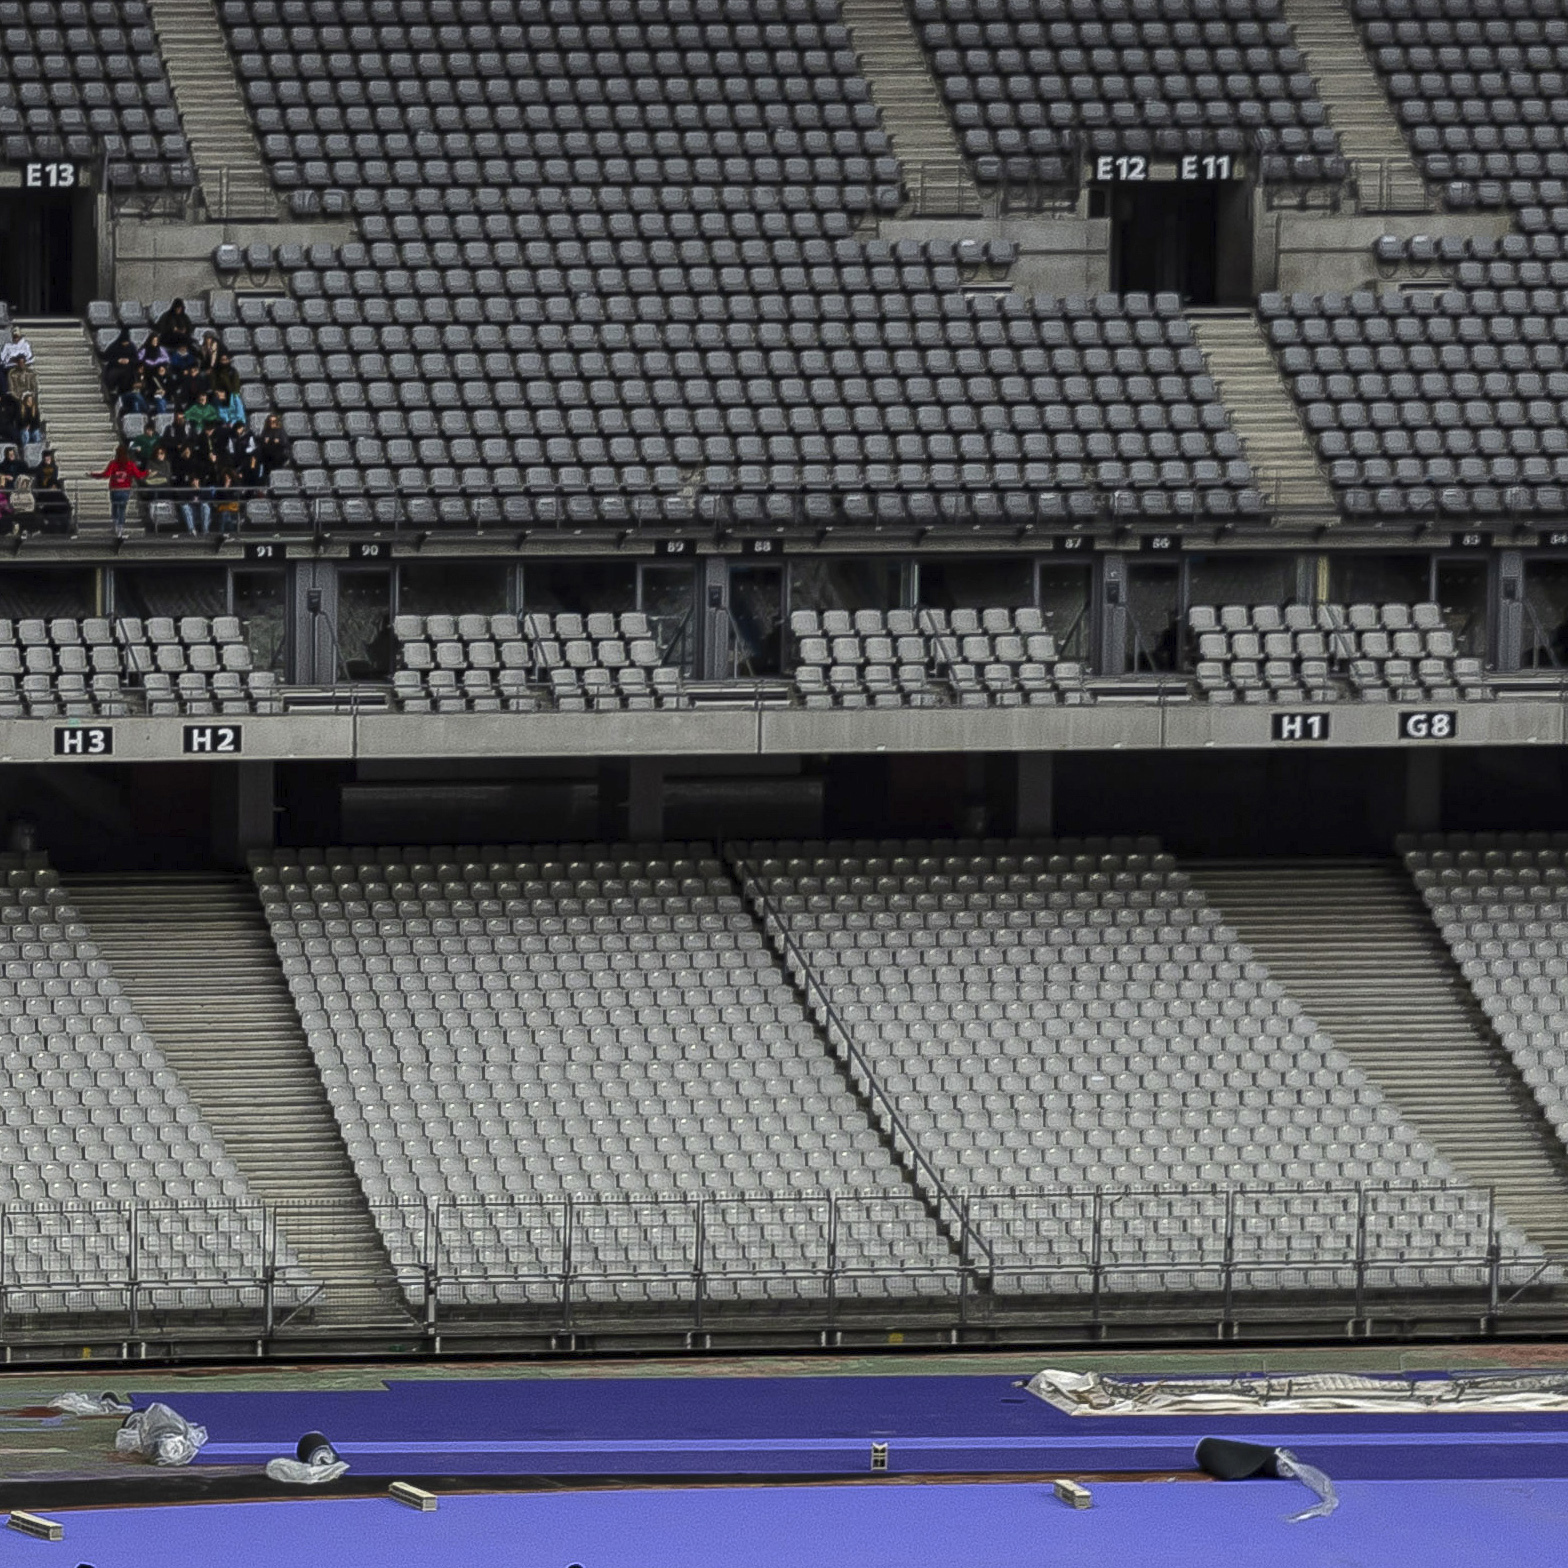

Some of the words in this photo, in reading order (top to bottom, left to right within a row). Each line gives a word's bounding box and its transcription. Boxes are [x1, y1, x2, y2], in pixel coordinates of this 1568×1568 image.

[26, 163, 74, 187] E13
[1097, 155, 1146, 180] E12
[1181, 155, 1230, 180] E11
[257, 546, 272, 557] 91
[361, 545, 378, 556] 90
[667, 541, 684, 553] 89
[754, 540, 771, 551] 88
[1282, 715, 1321, 739] H1
[1407, 713, 1450, 737] G8
[63, 730, 105, 753] H3
[191, 728, 234, 752] H2
